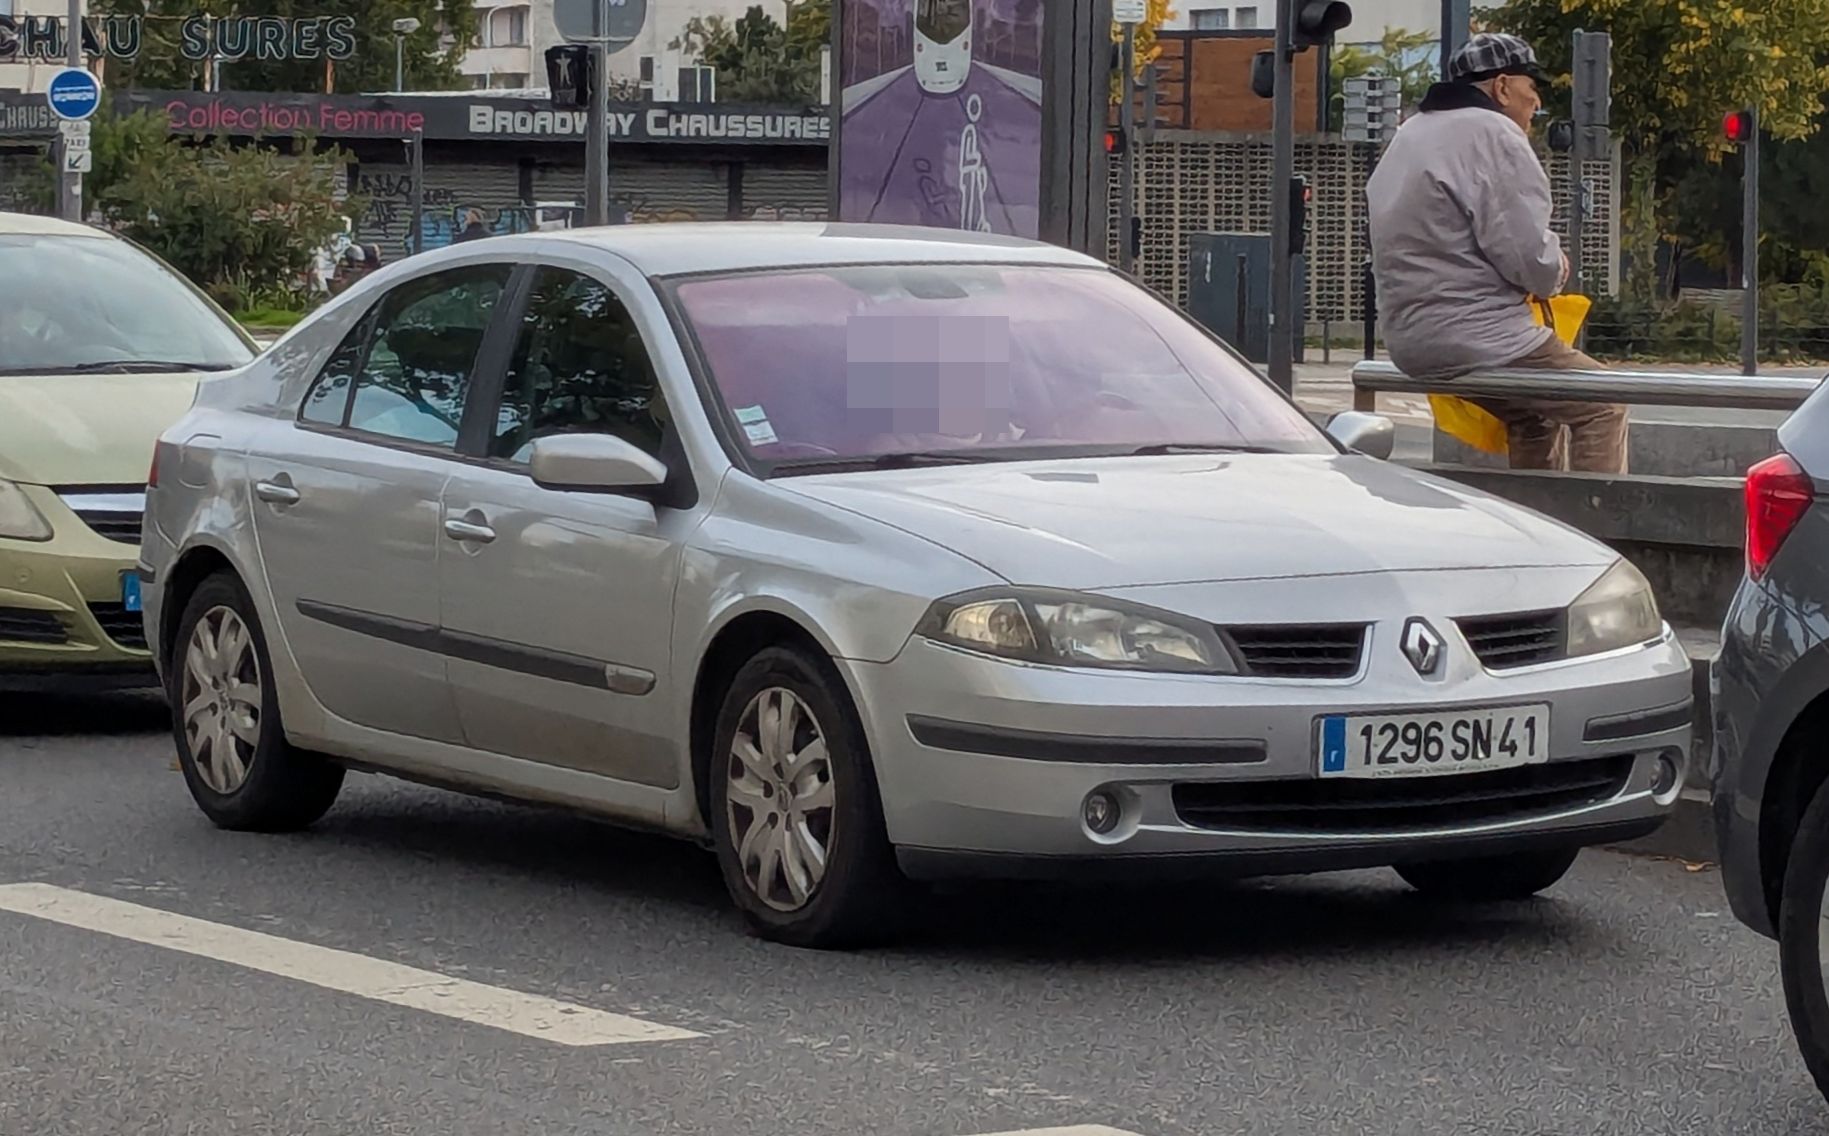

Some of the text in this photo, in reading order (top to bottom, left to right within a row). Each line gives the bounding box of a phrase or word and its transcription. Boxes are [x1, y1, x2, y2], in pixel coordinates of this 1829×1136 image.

[165, 100, 425, 132] Collection Femme
[646, 108, 831, 140] CHAUSSURES
[1360, 716, 1536, 765] 1296 SN 41
